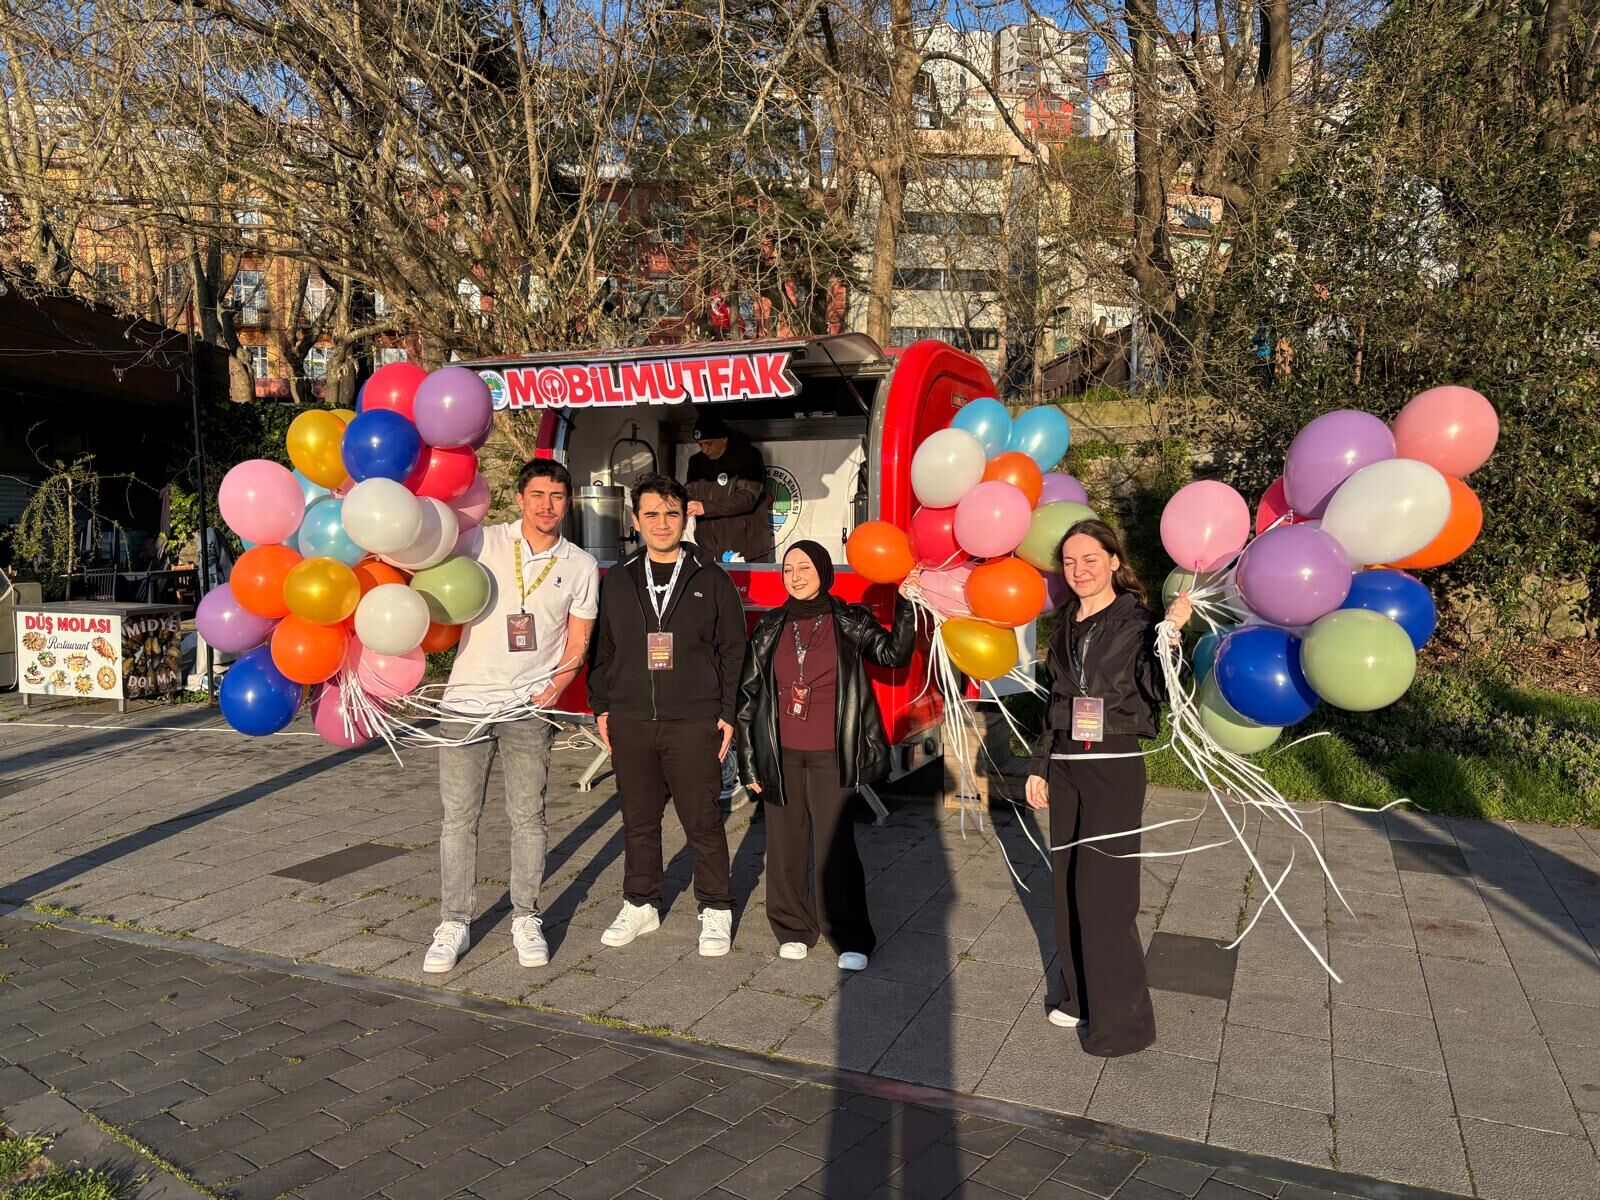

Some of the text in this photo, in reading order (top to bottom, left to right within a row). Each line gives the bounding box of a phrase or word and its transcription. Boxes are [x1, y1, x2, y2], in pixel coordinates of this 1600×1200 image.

[24, 612, 111, 635] DÜŞ MOLASI
[126, 617, 178, 639] MİDYE
[46, 635, 91, 651] Restaurant
[127, 670, 177, 689] DOLMA
